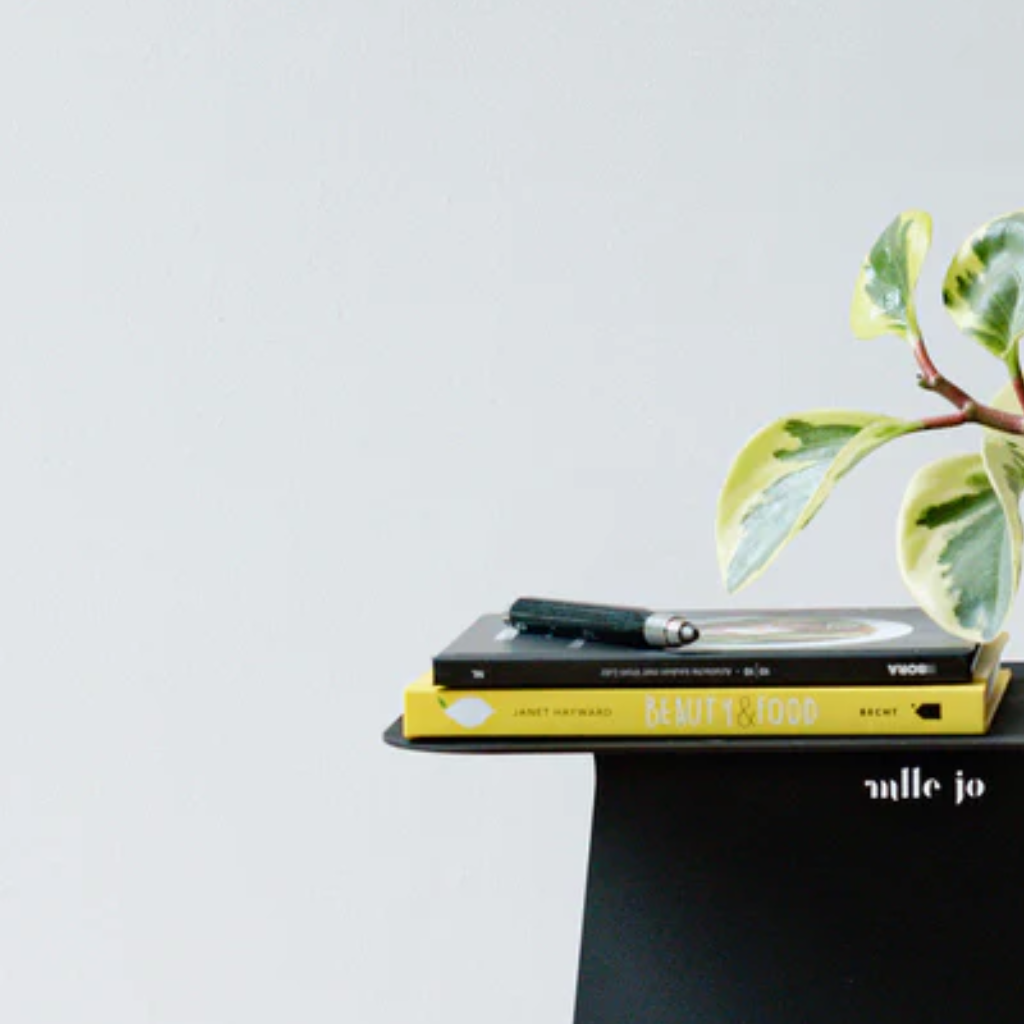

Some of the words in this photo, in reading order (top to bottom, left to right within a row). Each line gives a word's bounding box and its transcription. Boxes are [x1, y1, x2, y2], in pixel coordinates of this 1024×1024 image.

[512, 707, 549, 717] JANET
[553, 707, 613, 717] HAYWARD
[859, 707, 899, 718] BECHT
[954, 769, 985, 806] jo
